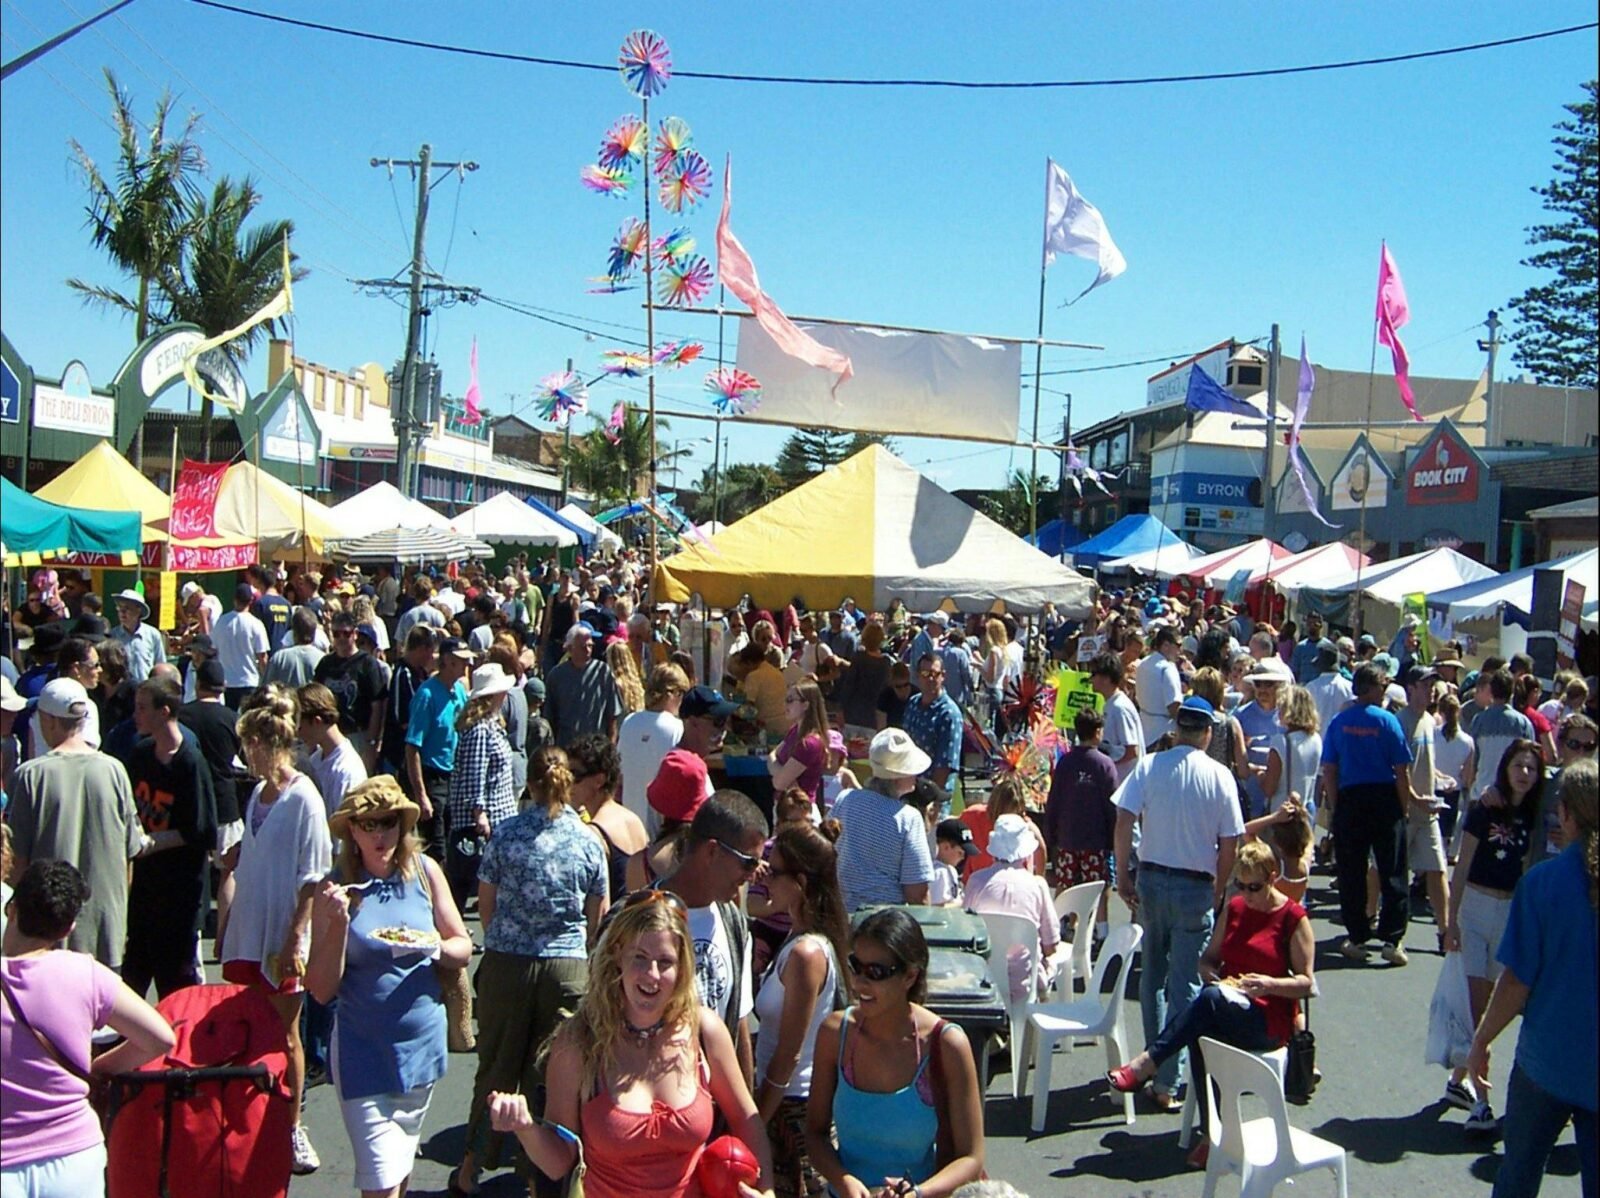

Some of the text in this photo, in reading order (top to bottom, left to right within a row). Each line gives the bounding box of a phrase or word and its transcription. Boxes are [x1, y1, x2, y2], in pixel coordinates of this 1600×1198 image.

[39, 396, 57, 418] THE
[60, 400, 81, 422] DELI
[1413, 466, 1467, 487] BOOK CITY
[1198, 483, 1245, 497] BYRON
